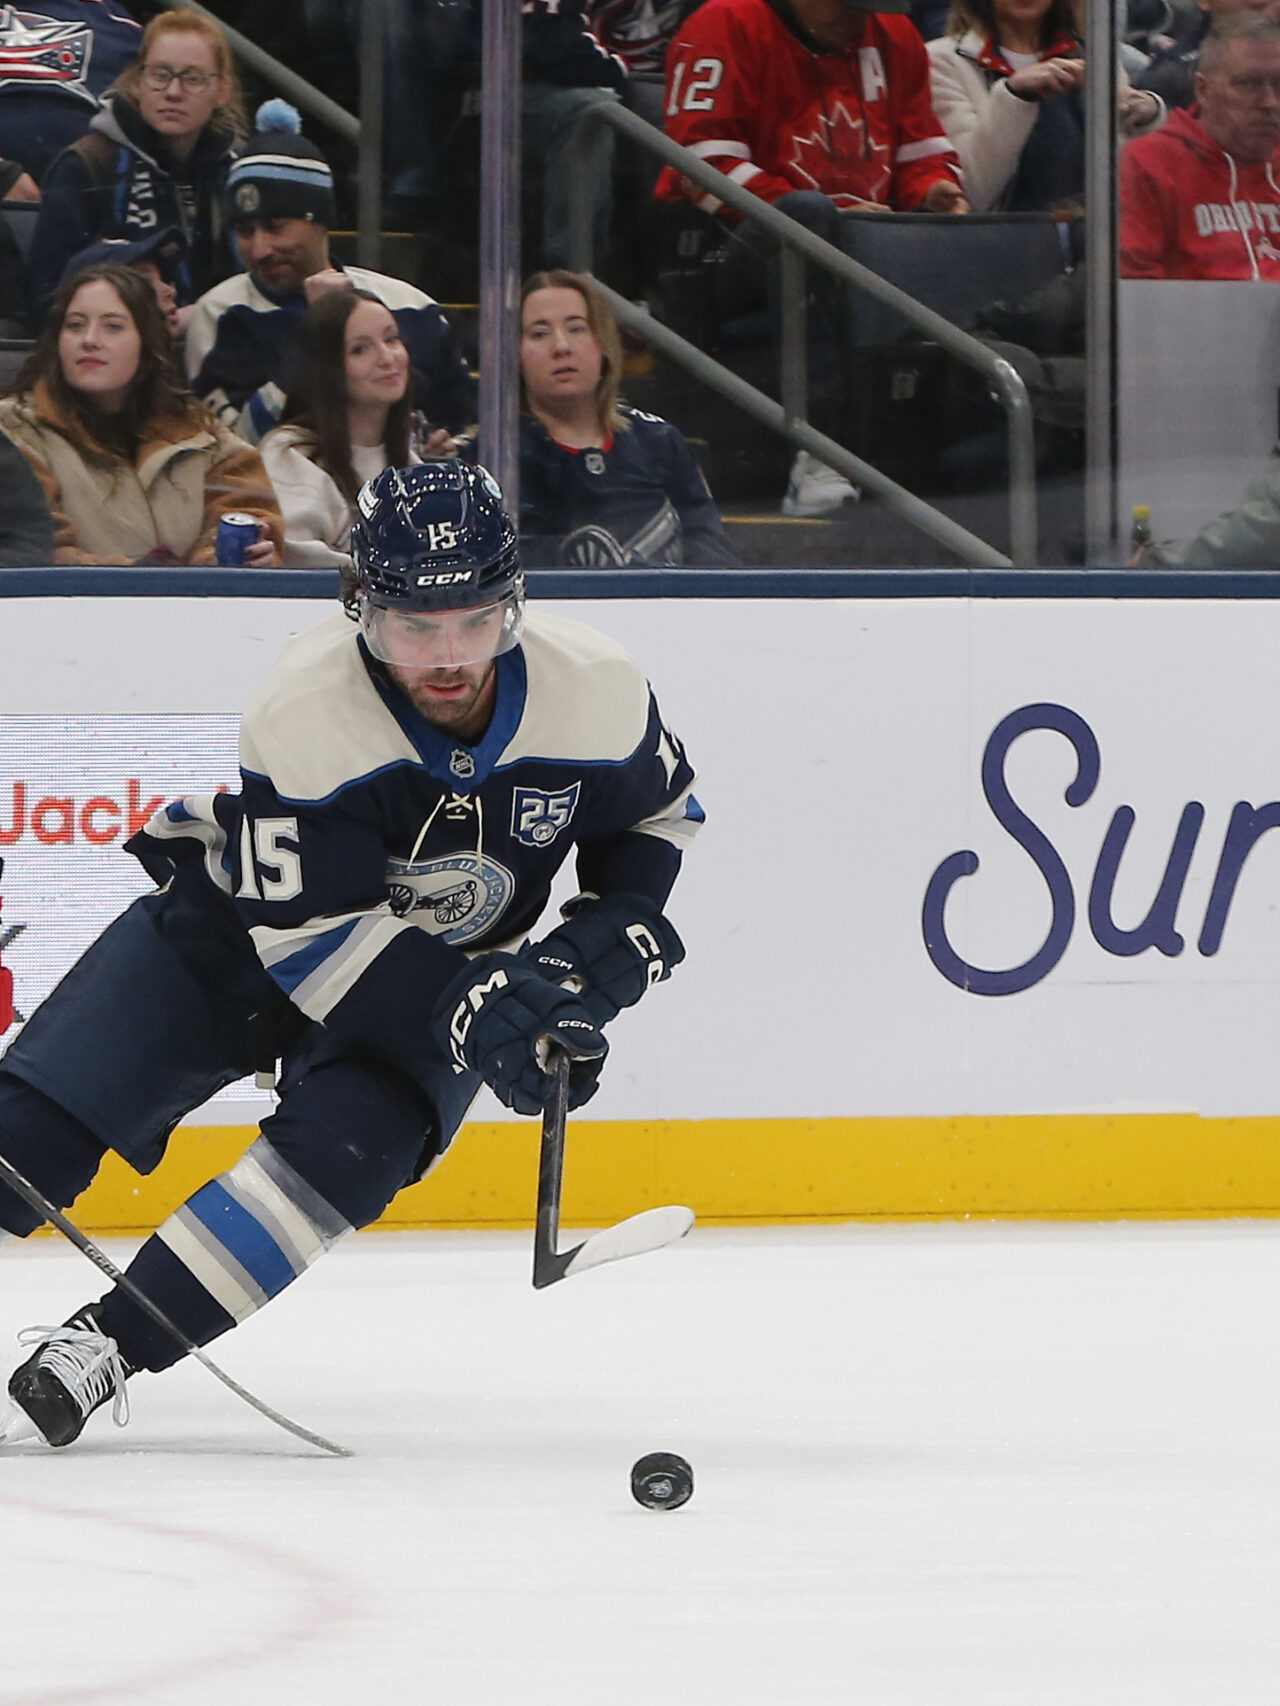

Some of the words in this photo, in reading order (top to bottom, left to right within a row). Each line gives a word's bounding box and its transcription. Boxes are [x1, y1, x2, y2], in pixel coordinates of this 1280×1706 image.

[666, 57, 724, 118] 12
[427, 521, 458, 551] 15
[416, 570, 473, 586] CCM
[520, 795, 571, 834] 25
[235, 813, 304, 901] 15
[538, 955, 574, 971] CCM
[557, 1019, 595, 1032] CCM
